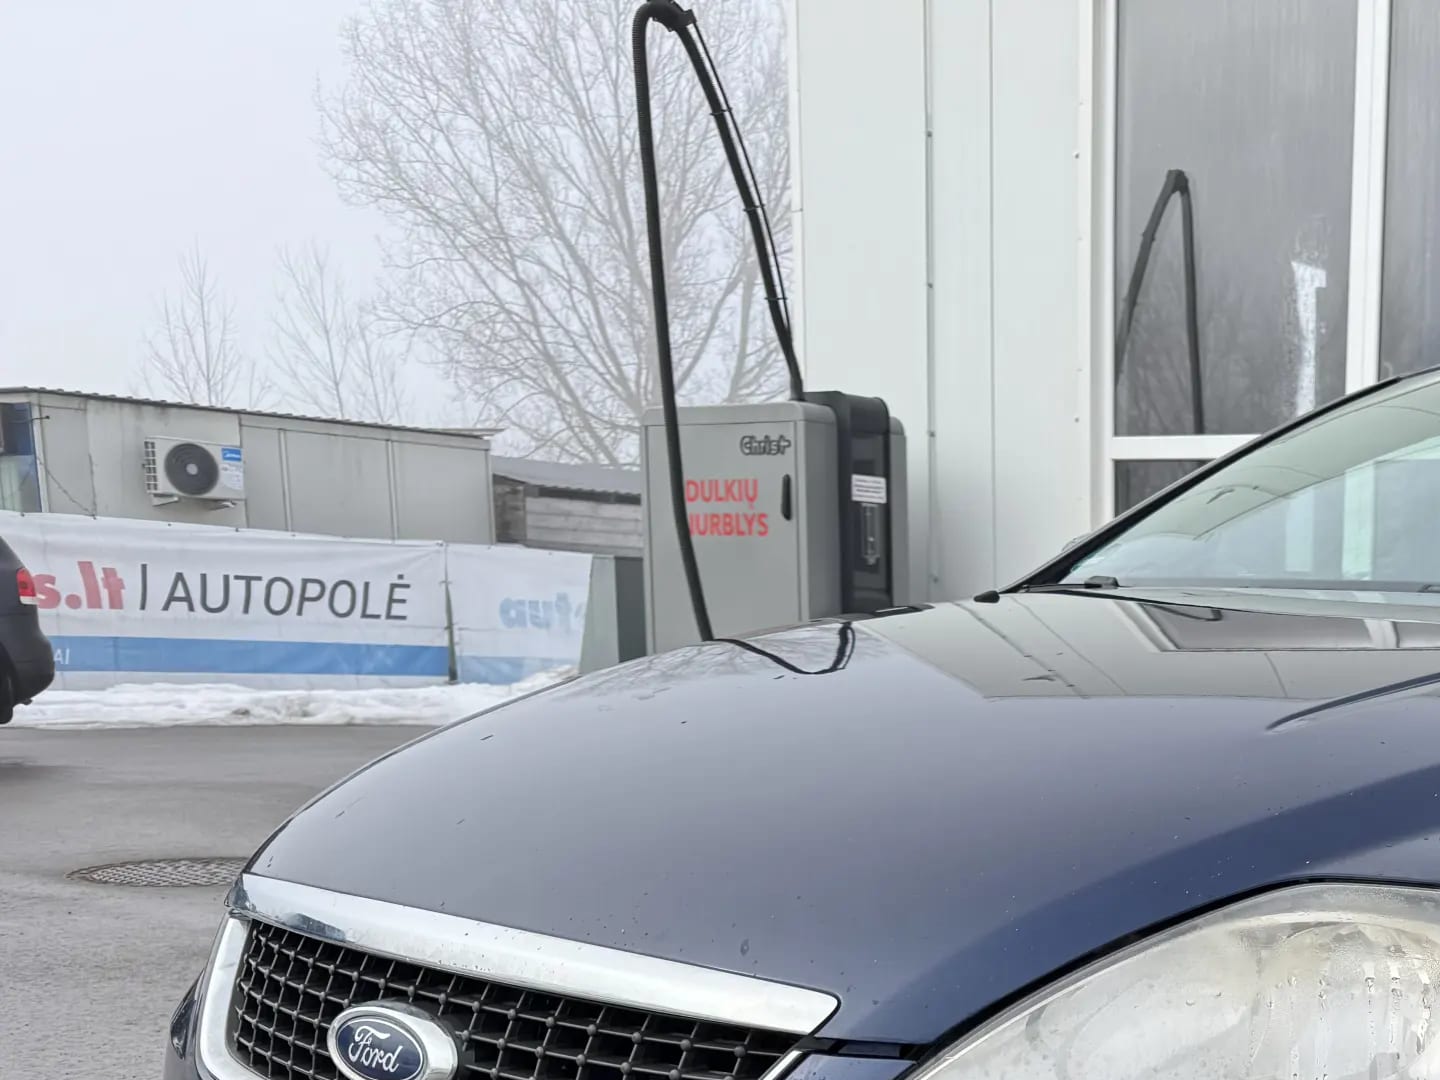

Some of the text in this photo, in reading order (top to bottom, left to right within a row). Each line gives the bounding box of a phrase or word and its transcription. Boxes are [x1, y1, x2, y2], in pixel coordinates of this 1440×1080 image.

[688, 512, 769, 537] IURBLYS
[34, 561, 411, 621] s.lt AUTOPOLĖ
[348, 1025, 403, 1073] Ford
